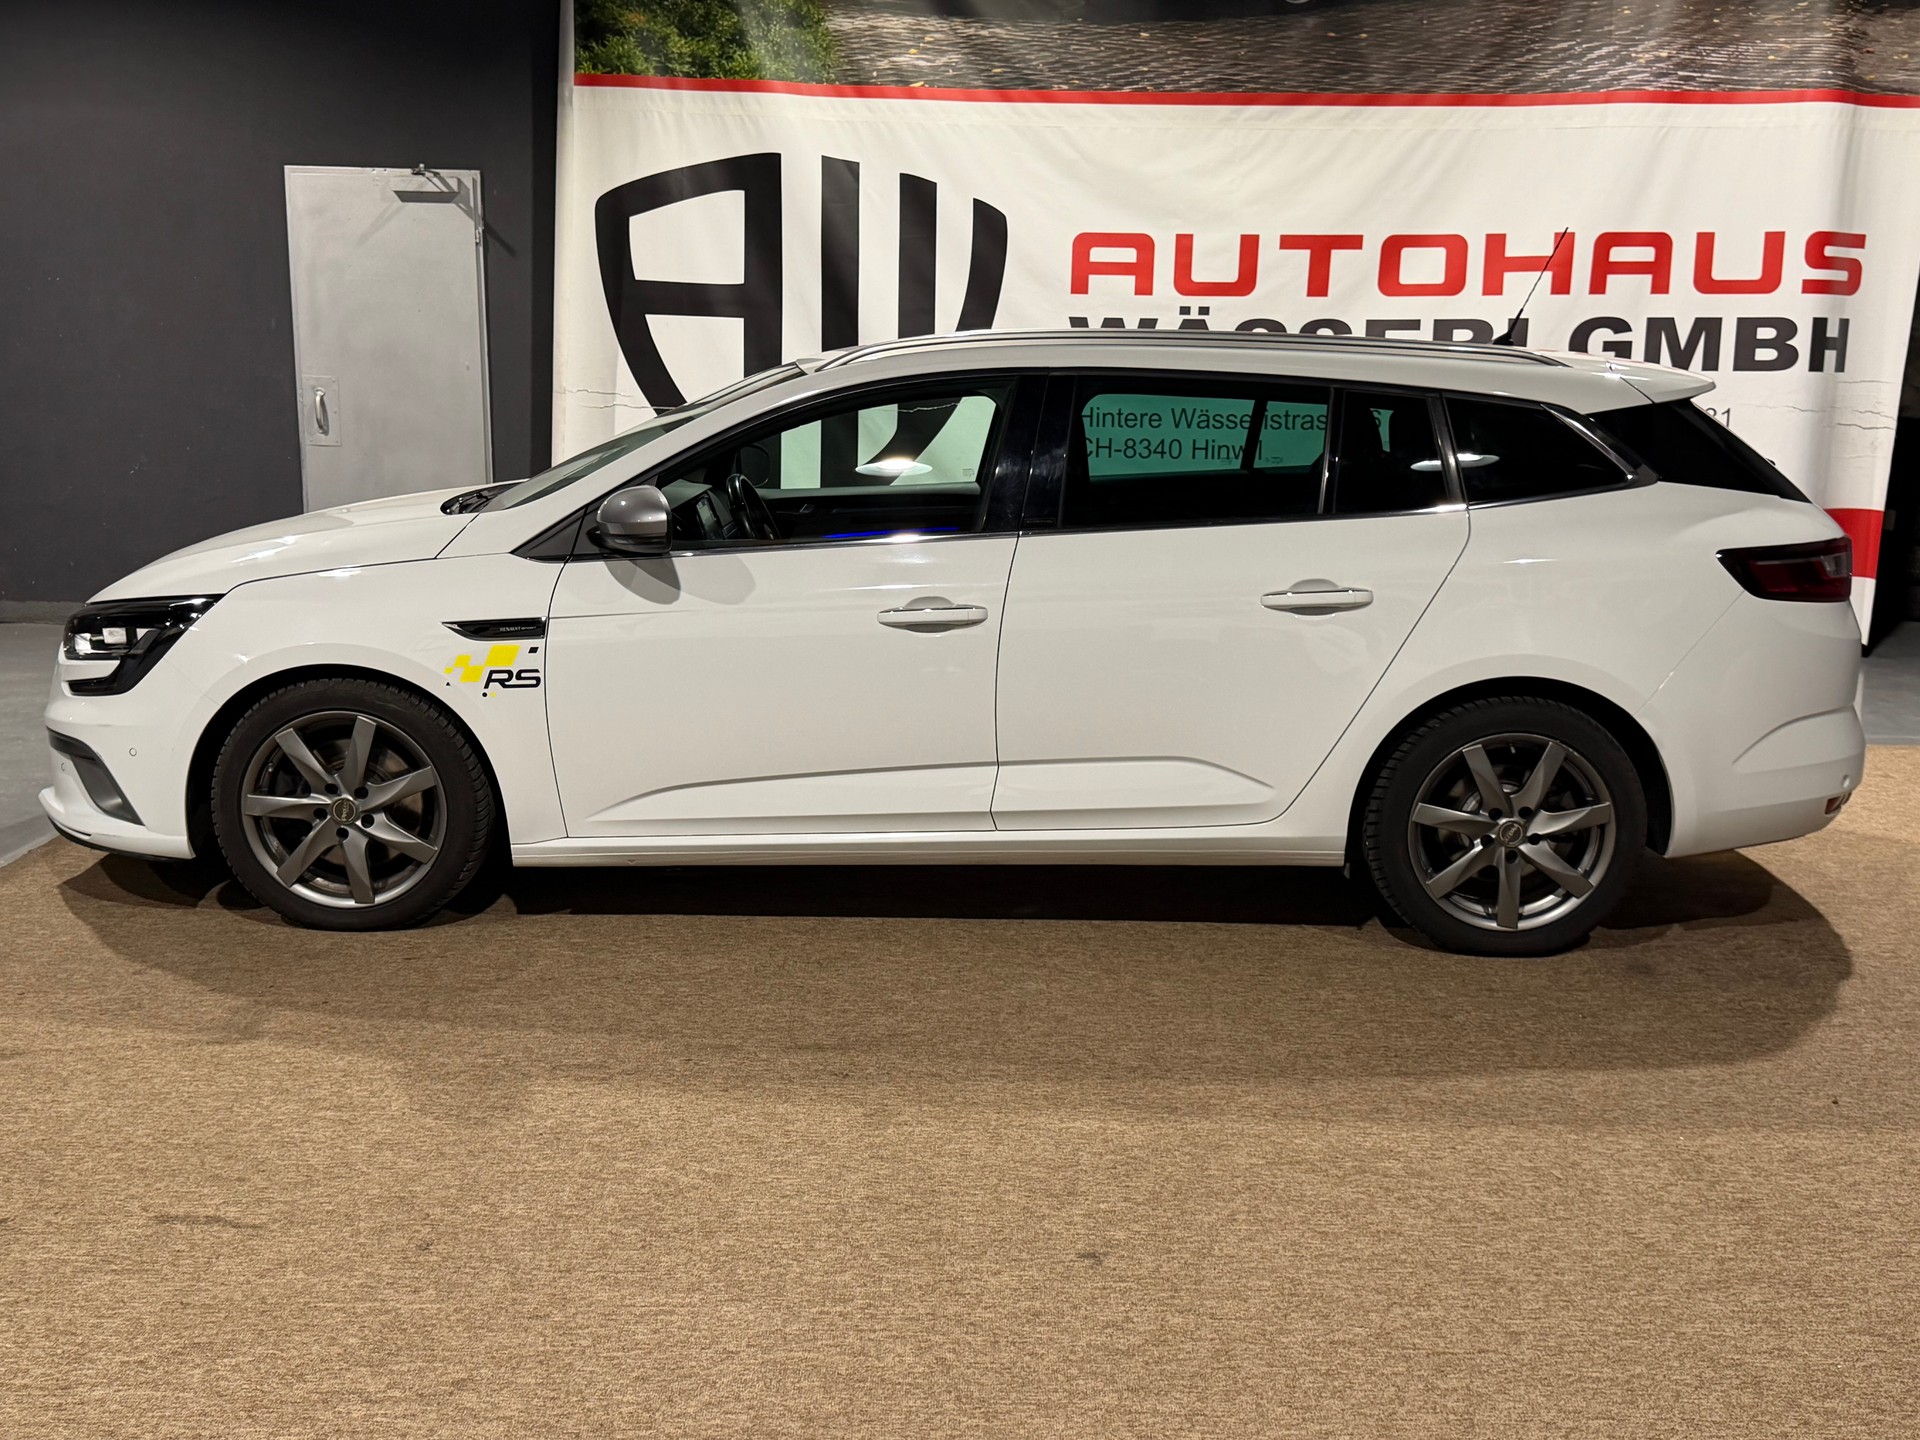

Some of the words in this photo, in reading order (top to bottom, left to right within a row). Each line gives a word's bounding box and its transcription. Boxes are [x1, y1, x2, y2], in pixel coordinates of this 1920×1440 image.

[1070, 231, 1867, 297] AUTOHAUS
[1568, 316, 1850, 373] GMBH
[1081, 407, 1162, 430] Hintere
[1171, 408, 1328, 431] Wässeistras
[1192, 438, 1263, 461] Hinwl
[483, 668, 541, 689] RS
